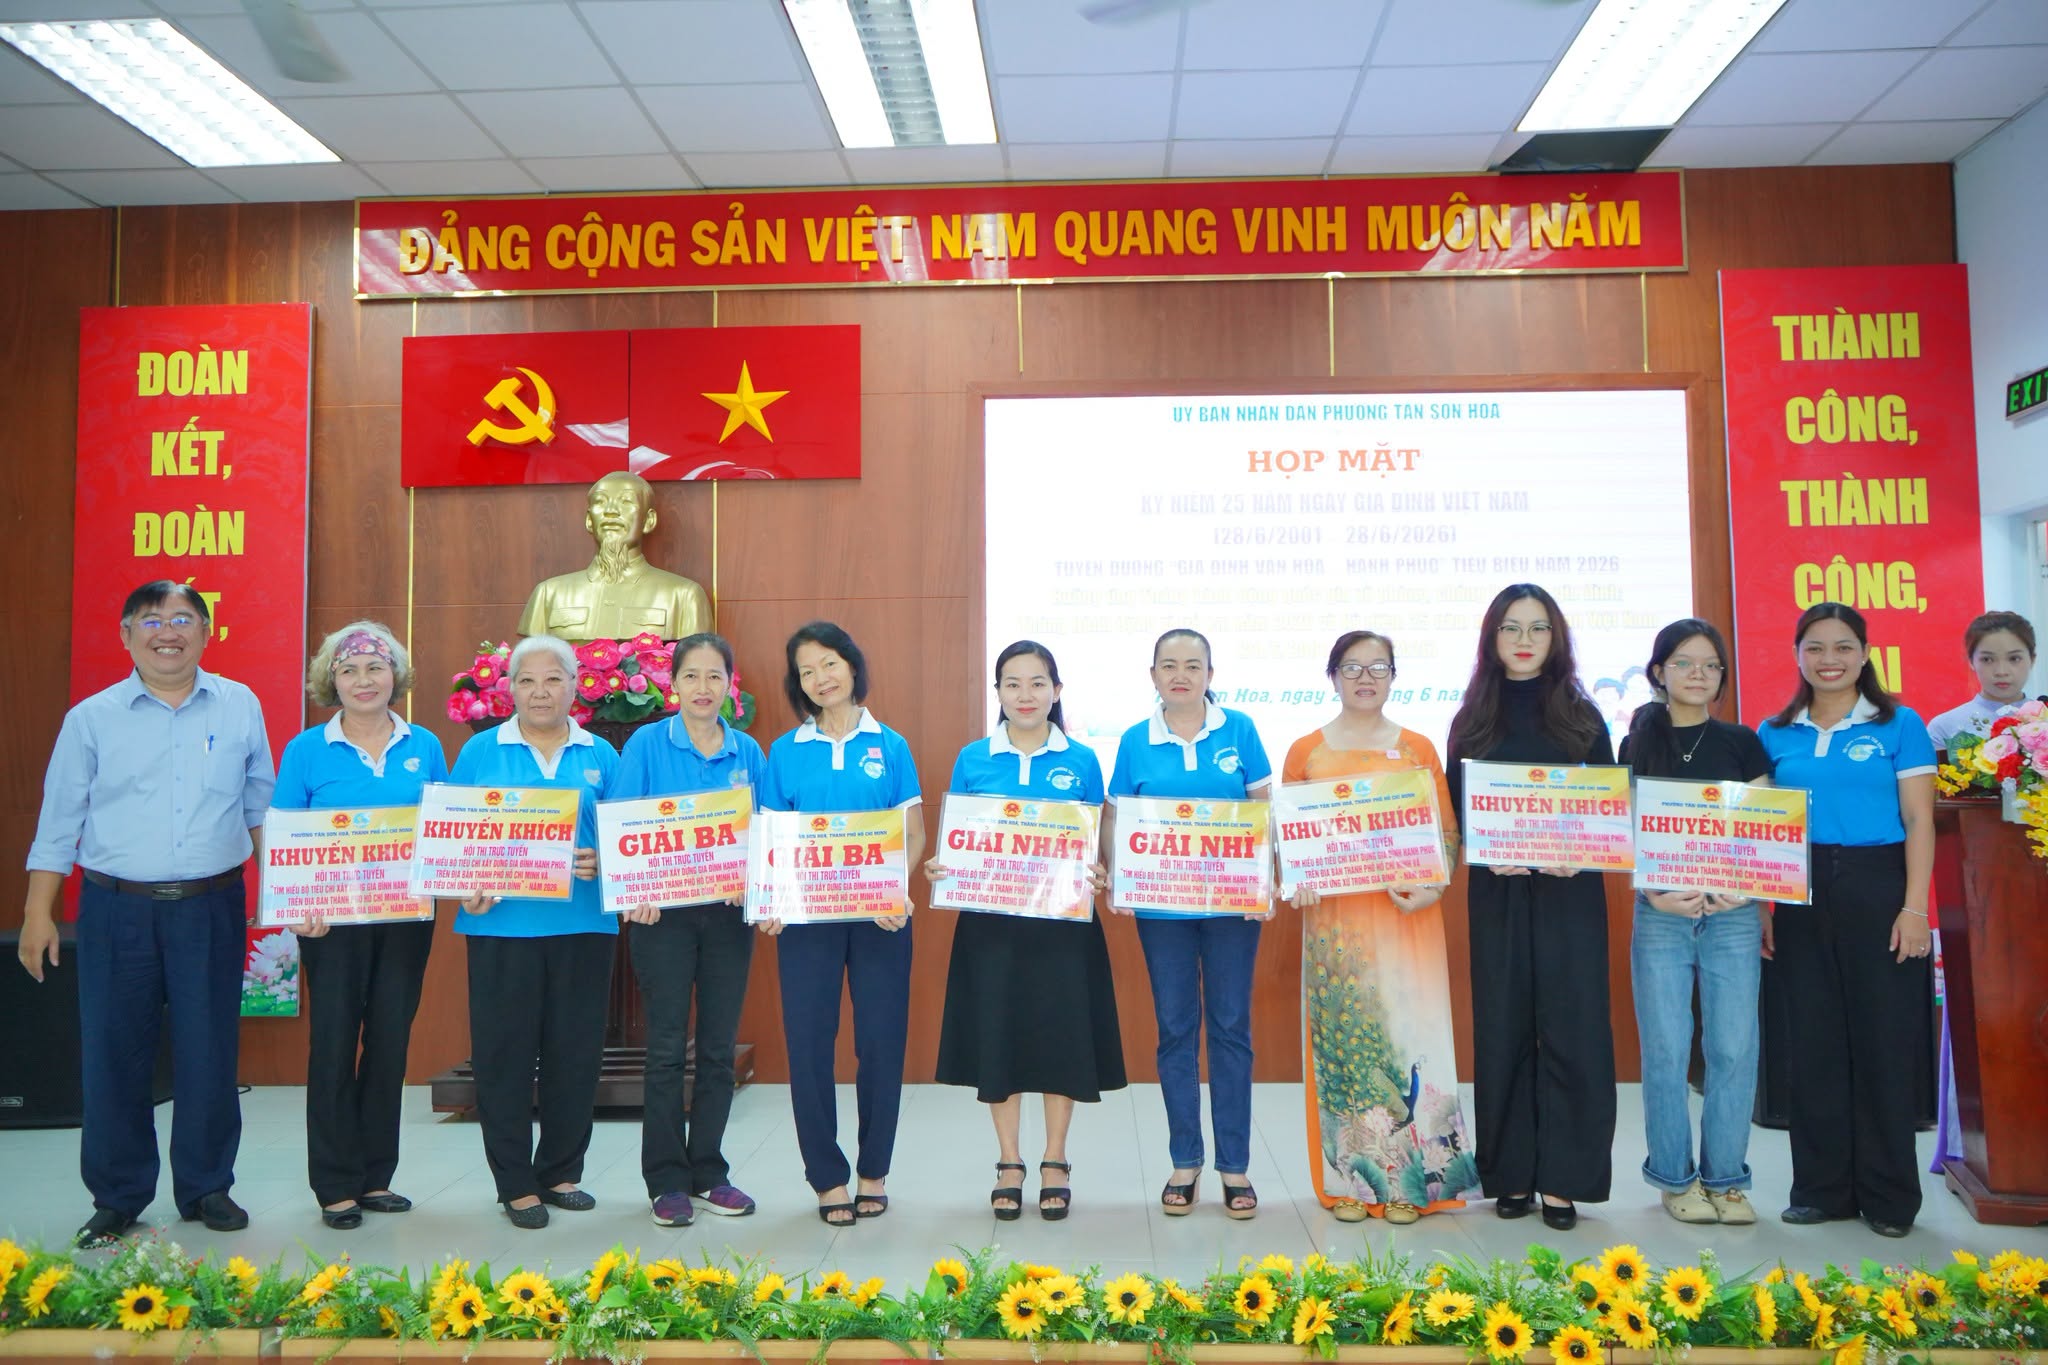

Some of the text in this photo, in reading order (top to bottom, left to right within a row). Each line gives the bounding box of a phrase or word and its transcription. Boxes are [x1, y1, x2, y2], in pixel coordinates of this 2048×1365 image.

[399, 192, 1641, 278] ĐẢNG CỘNG SẢN VIỆT NAM QUANG VINH MUÔN NĂM
[1772, 307, 1920, 361] THÀNH
[137, 344, 248, 397] ĐOÀN
[1785, 388, 1919, 446] CÔNG,
[151, 416, 232, 480] KẾT,
[1247, 441, 1421, 480] HỌP MẶT
[1222, 494, 1245, 513] 25
[1780, 472, 1929, 526] THÀNH
[133, 505, 244, 557] ĐOÀN
[1577, 555, 1619, 573] 2026
[1793, 554, 1927, 614] CÔNG,
[1472, 792, 1628, 816] KHUYẾN KHÍCH
[423, 817, 573, 841] KHUYẾN KHÍCH
[1282, 806, 1433, 841] KHUYẾN KHÍCH
[1528, 819, 1539, 829] THI
[1641, 813, 1803, 843] KHUYẾN KHÍCH
[477, 847, 487, 856] THI
[619, 823, 737, 857] GIẢI BA
[948, 826, 1087, 860] GIẢI NHẤT
[1129, 828, 1255, 858] GIẢI NHÌ
[1340, 841, 1350, 852] THI
[1700, 842, 1711, 851] THI
[270, 840, 412, 866] KHUYẾN KHÍC
[648, 851, 714, 867] HỘI THI TRỰC TUYẾN
[843, 844, 884, 866] BA
[997, 859, 1006, 868] THI
[1173, 860, 1183, 869] THI
[330, 870, 340, 881] THI
[697, 865, 708, 874] GIA
[716, 873, 731, 882] MINH
[809, 870, 818, 880] THI
[671, 889, 689, 899] TRONG
[690, 888, 700, 897] GIA
